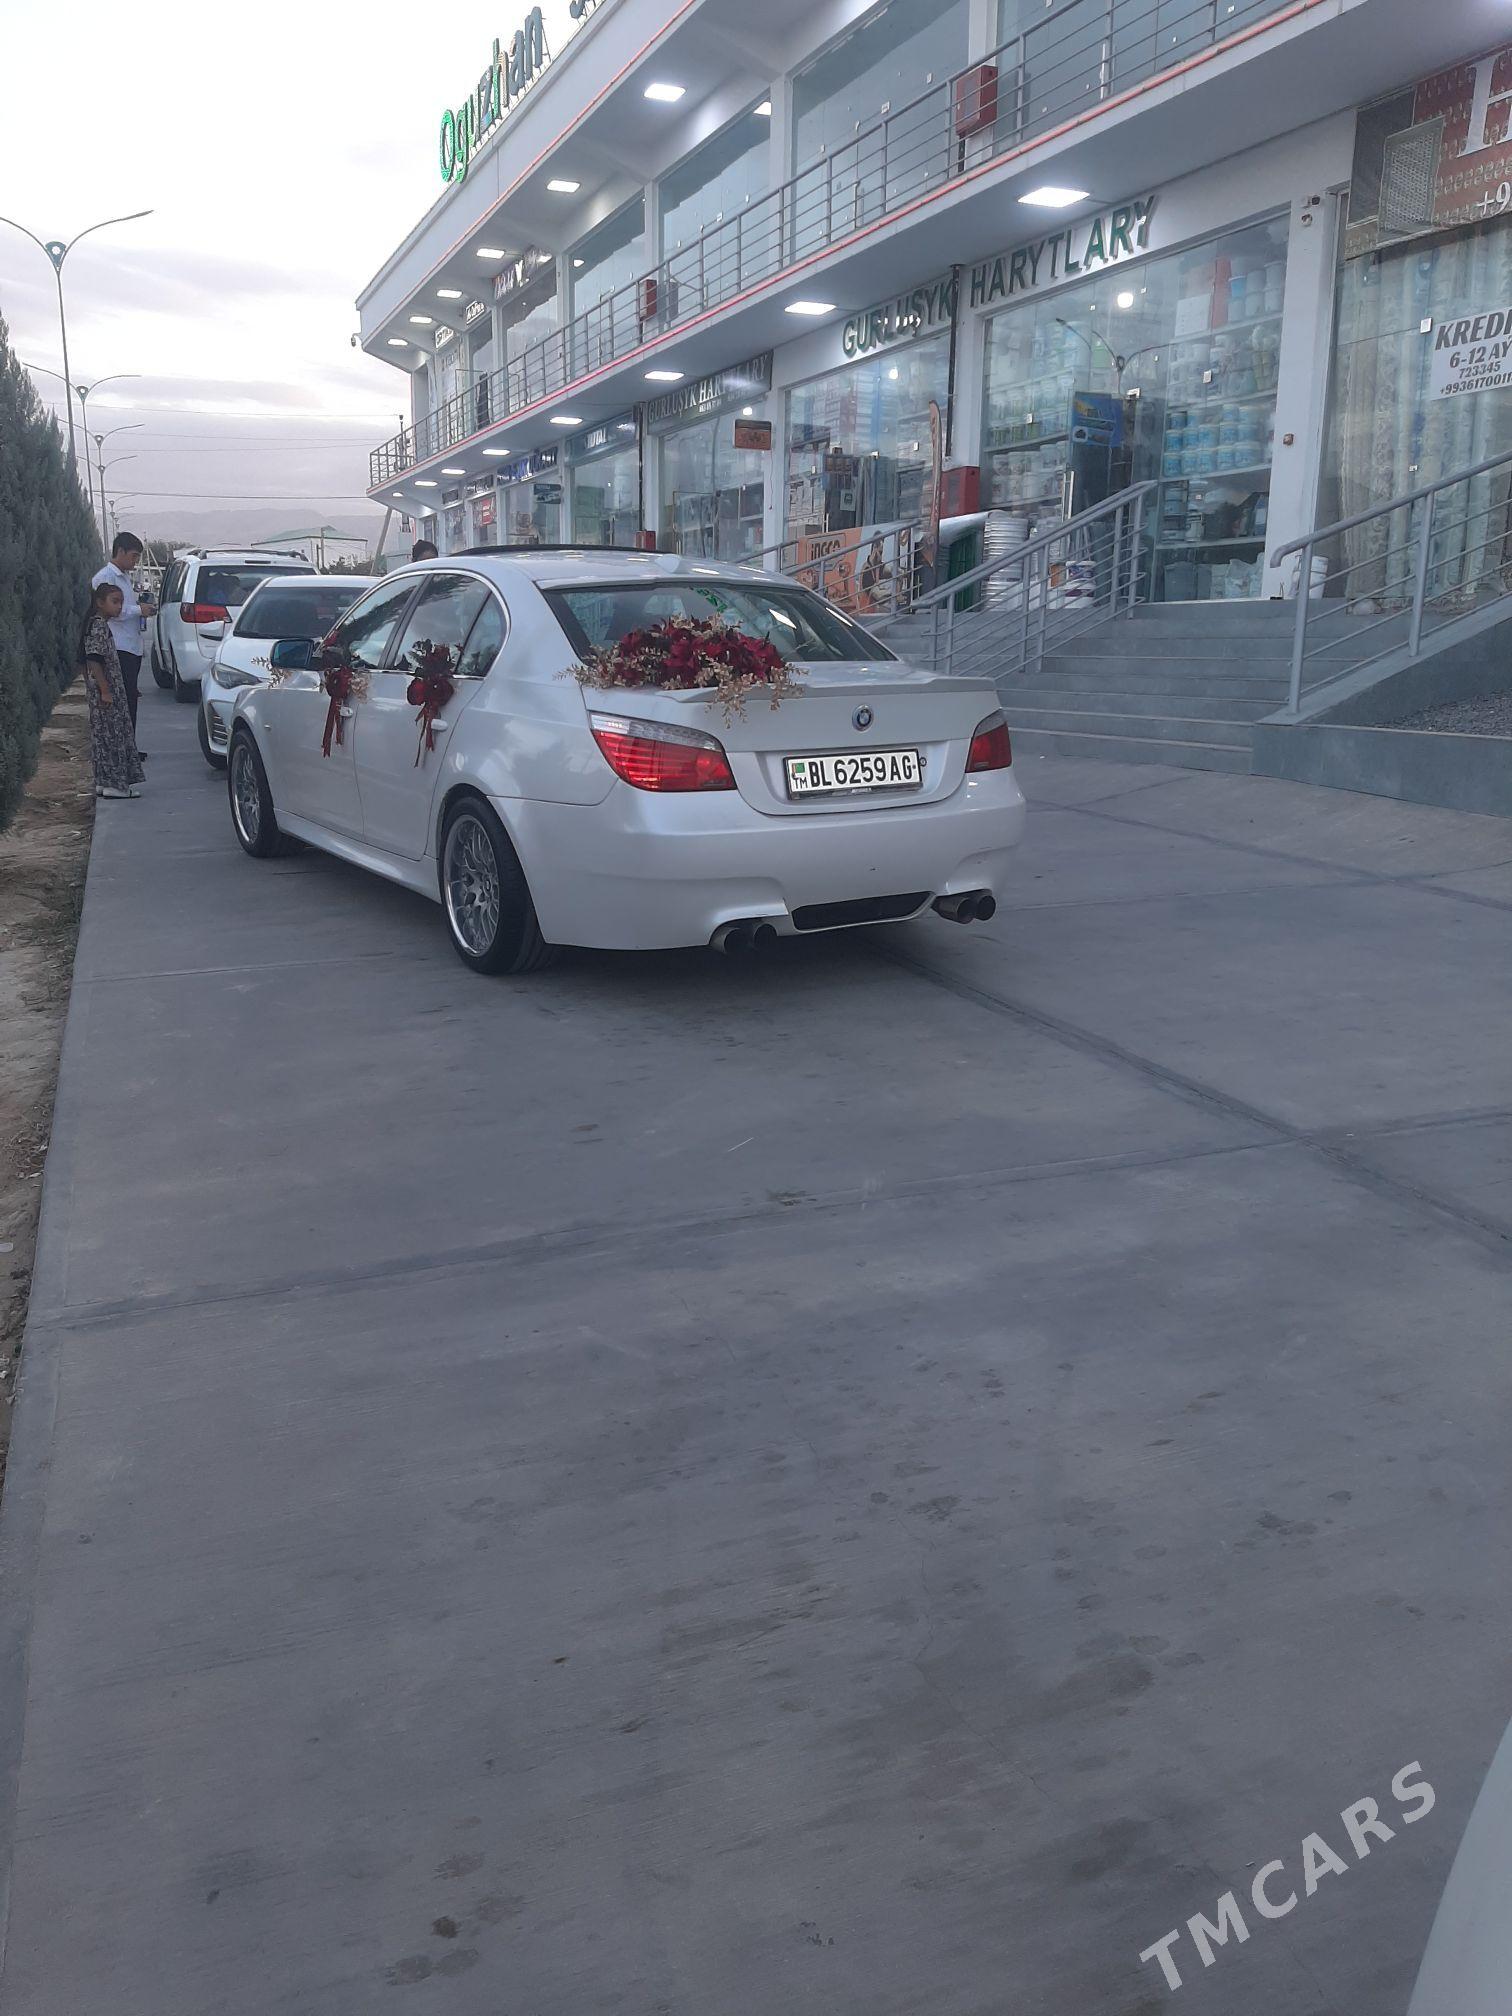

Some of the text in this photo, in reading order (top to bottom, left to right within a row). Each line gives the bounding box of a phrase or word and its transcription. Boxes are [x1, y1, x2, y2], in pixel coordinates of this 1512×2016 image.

[969, 195, 1155, 308] HARYTLARY
[1449, 346, 1487, 369] 6-12
[1458, 360, 1501, 379] 723345
[1440, 371, 1512, 394] +9936170011
